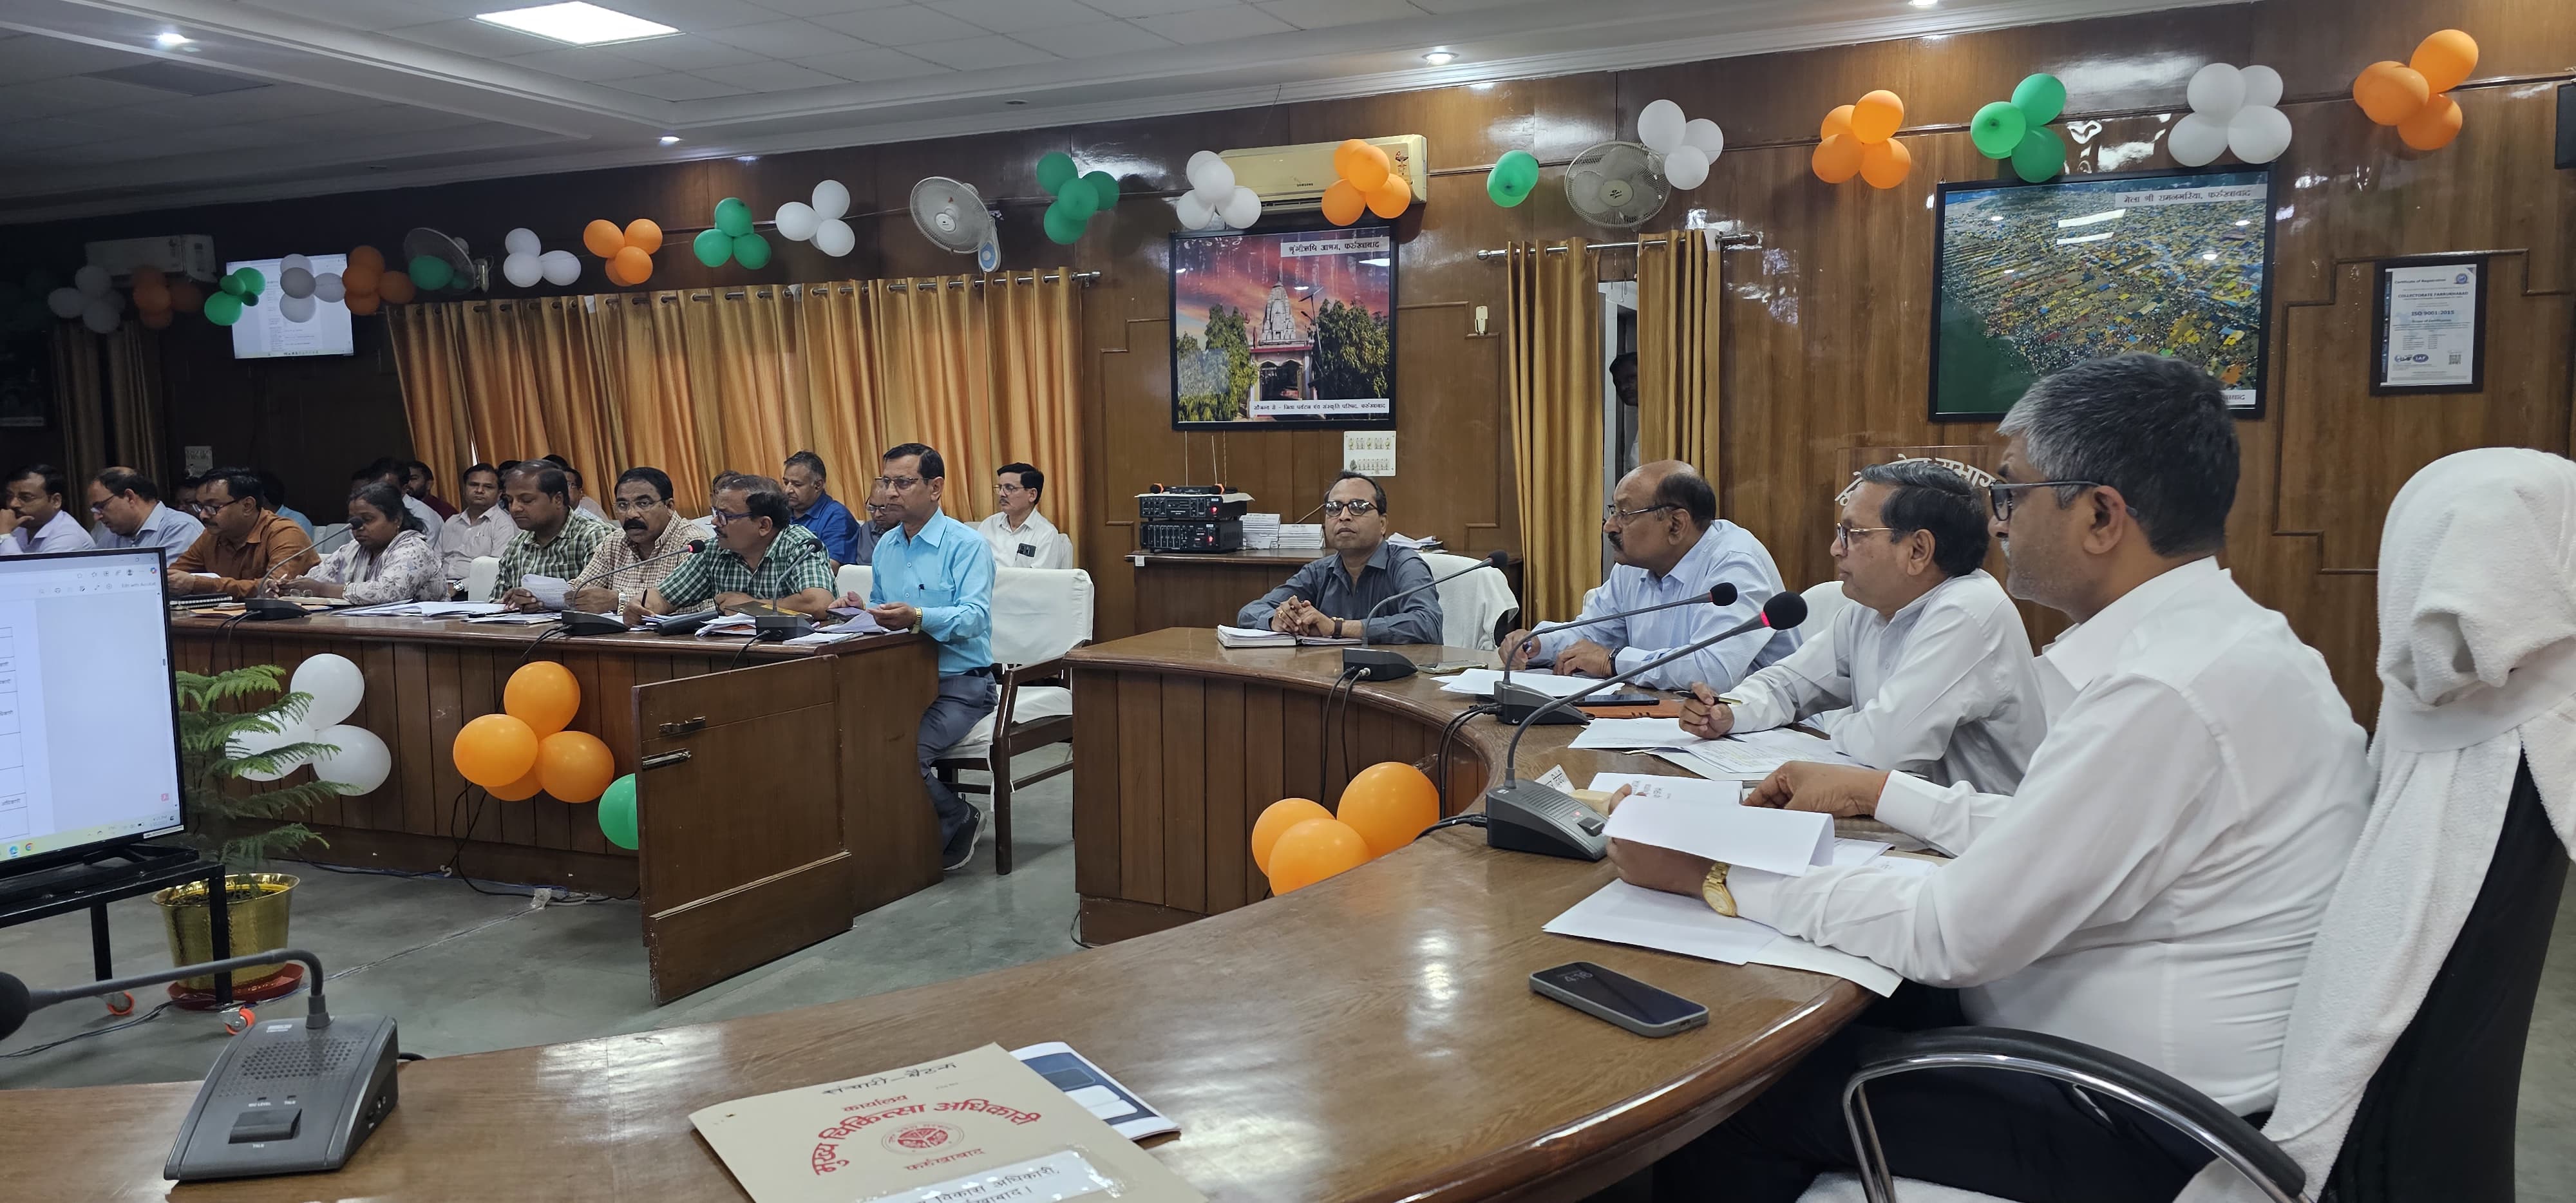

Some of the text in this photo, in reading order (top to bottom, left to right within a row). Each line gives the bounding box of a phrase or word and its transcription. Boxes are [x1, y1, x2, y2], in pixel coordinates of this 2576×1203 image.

[2124, 194, 2140, 204] मेला
[2145, 194, 2154, 202] श्री
[842, 1095, 909, 1112] कार्यालय
[933, 1098, 1042, 1126] अधिकारी
[818, 1103, 927, 1140] चिकित्सा
[811, 1142, 850, 1176] मुख्य
